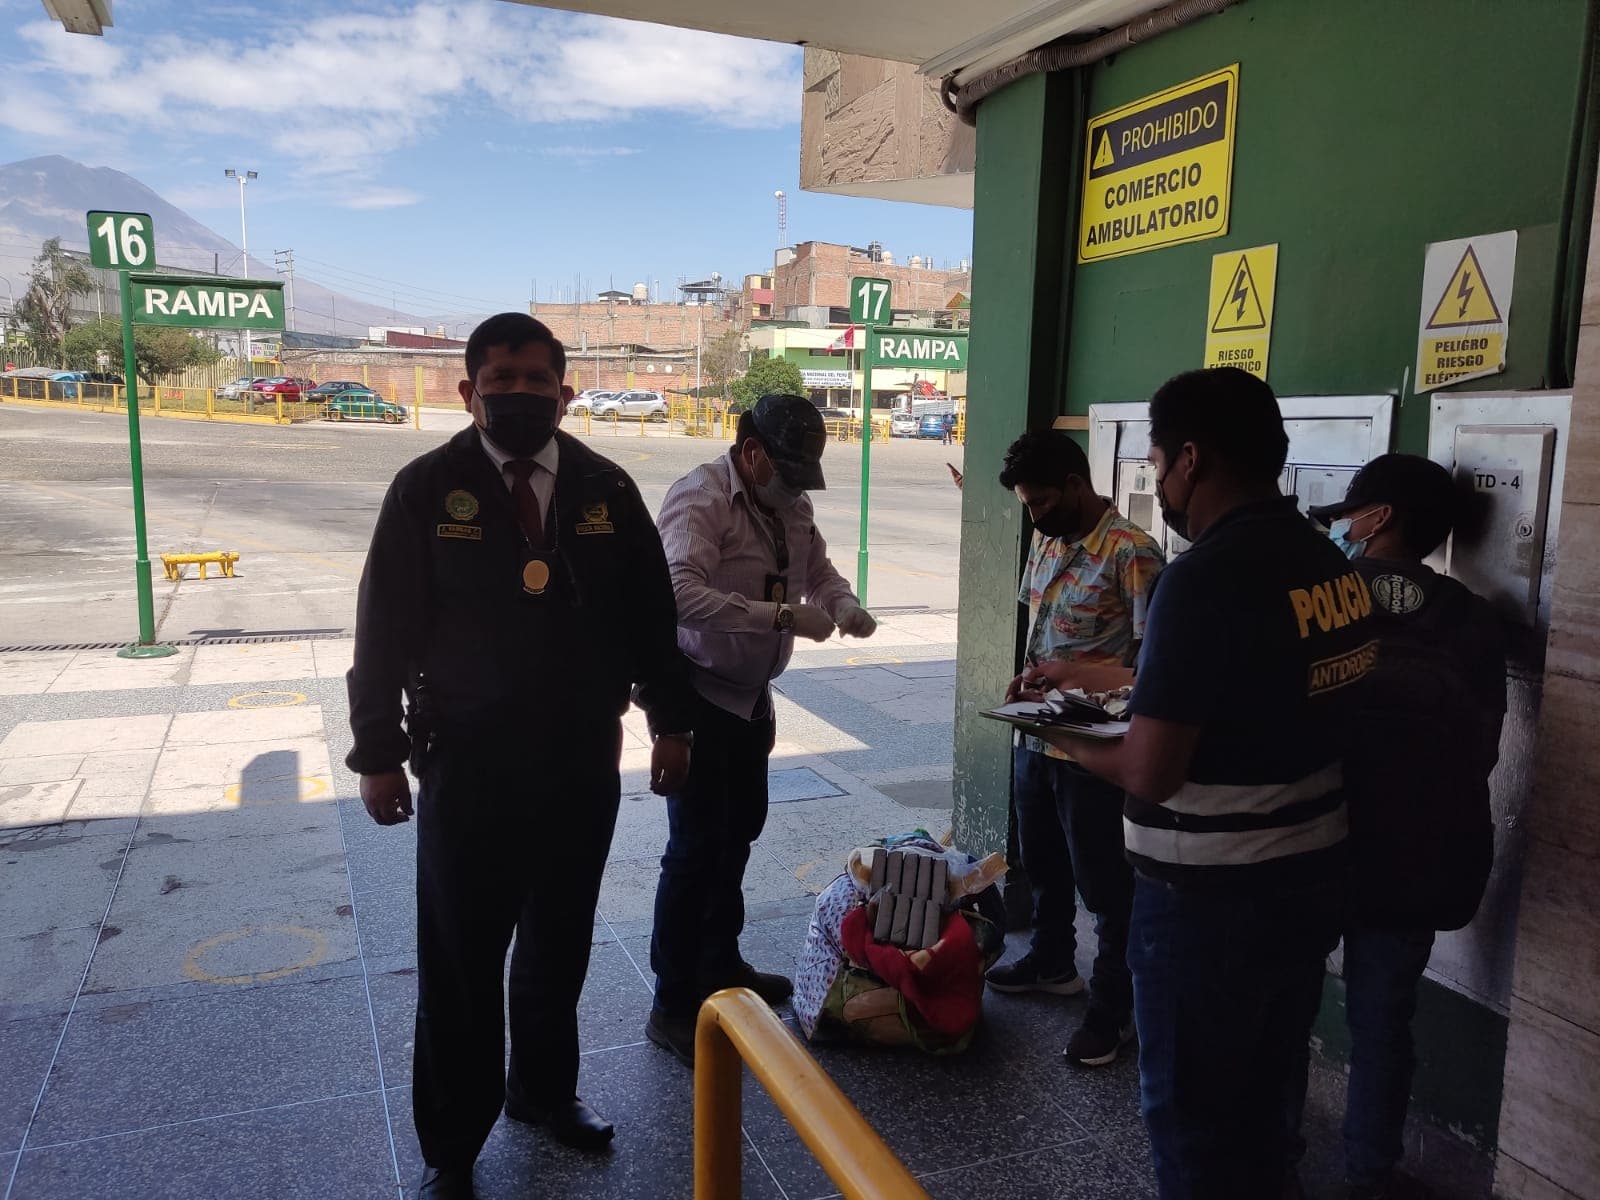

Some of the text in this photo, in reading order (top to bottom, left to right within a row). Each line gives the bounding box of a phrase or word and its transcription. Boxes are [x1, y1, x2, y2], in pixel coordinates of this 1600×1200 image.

[1120, 101, 1218, 156] PROHIBIDO
[1104, 162, 1202, 210] COMERCIO
[1086, 194, 1219, 247] AMBULATORIO
[97, 216, 148, 266] 16
[144, 288, 274, 319] RAMPA
[858, 281, 889, 320] 17
[879, 337, 960, 361] RAMPA
[1218, 348, 1255, 361] RIESGO
[1434, 338, 1489, 353] PELIGRO
[1437, 354, 1484, 369] RIESGO
[1476, 474, 1497, 488] TD
[1510, 475, 1520, 490] 4
